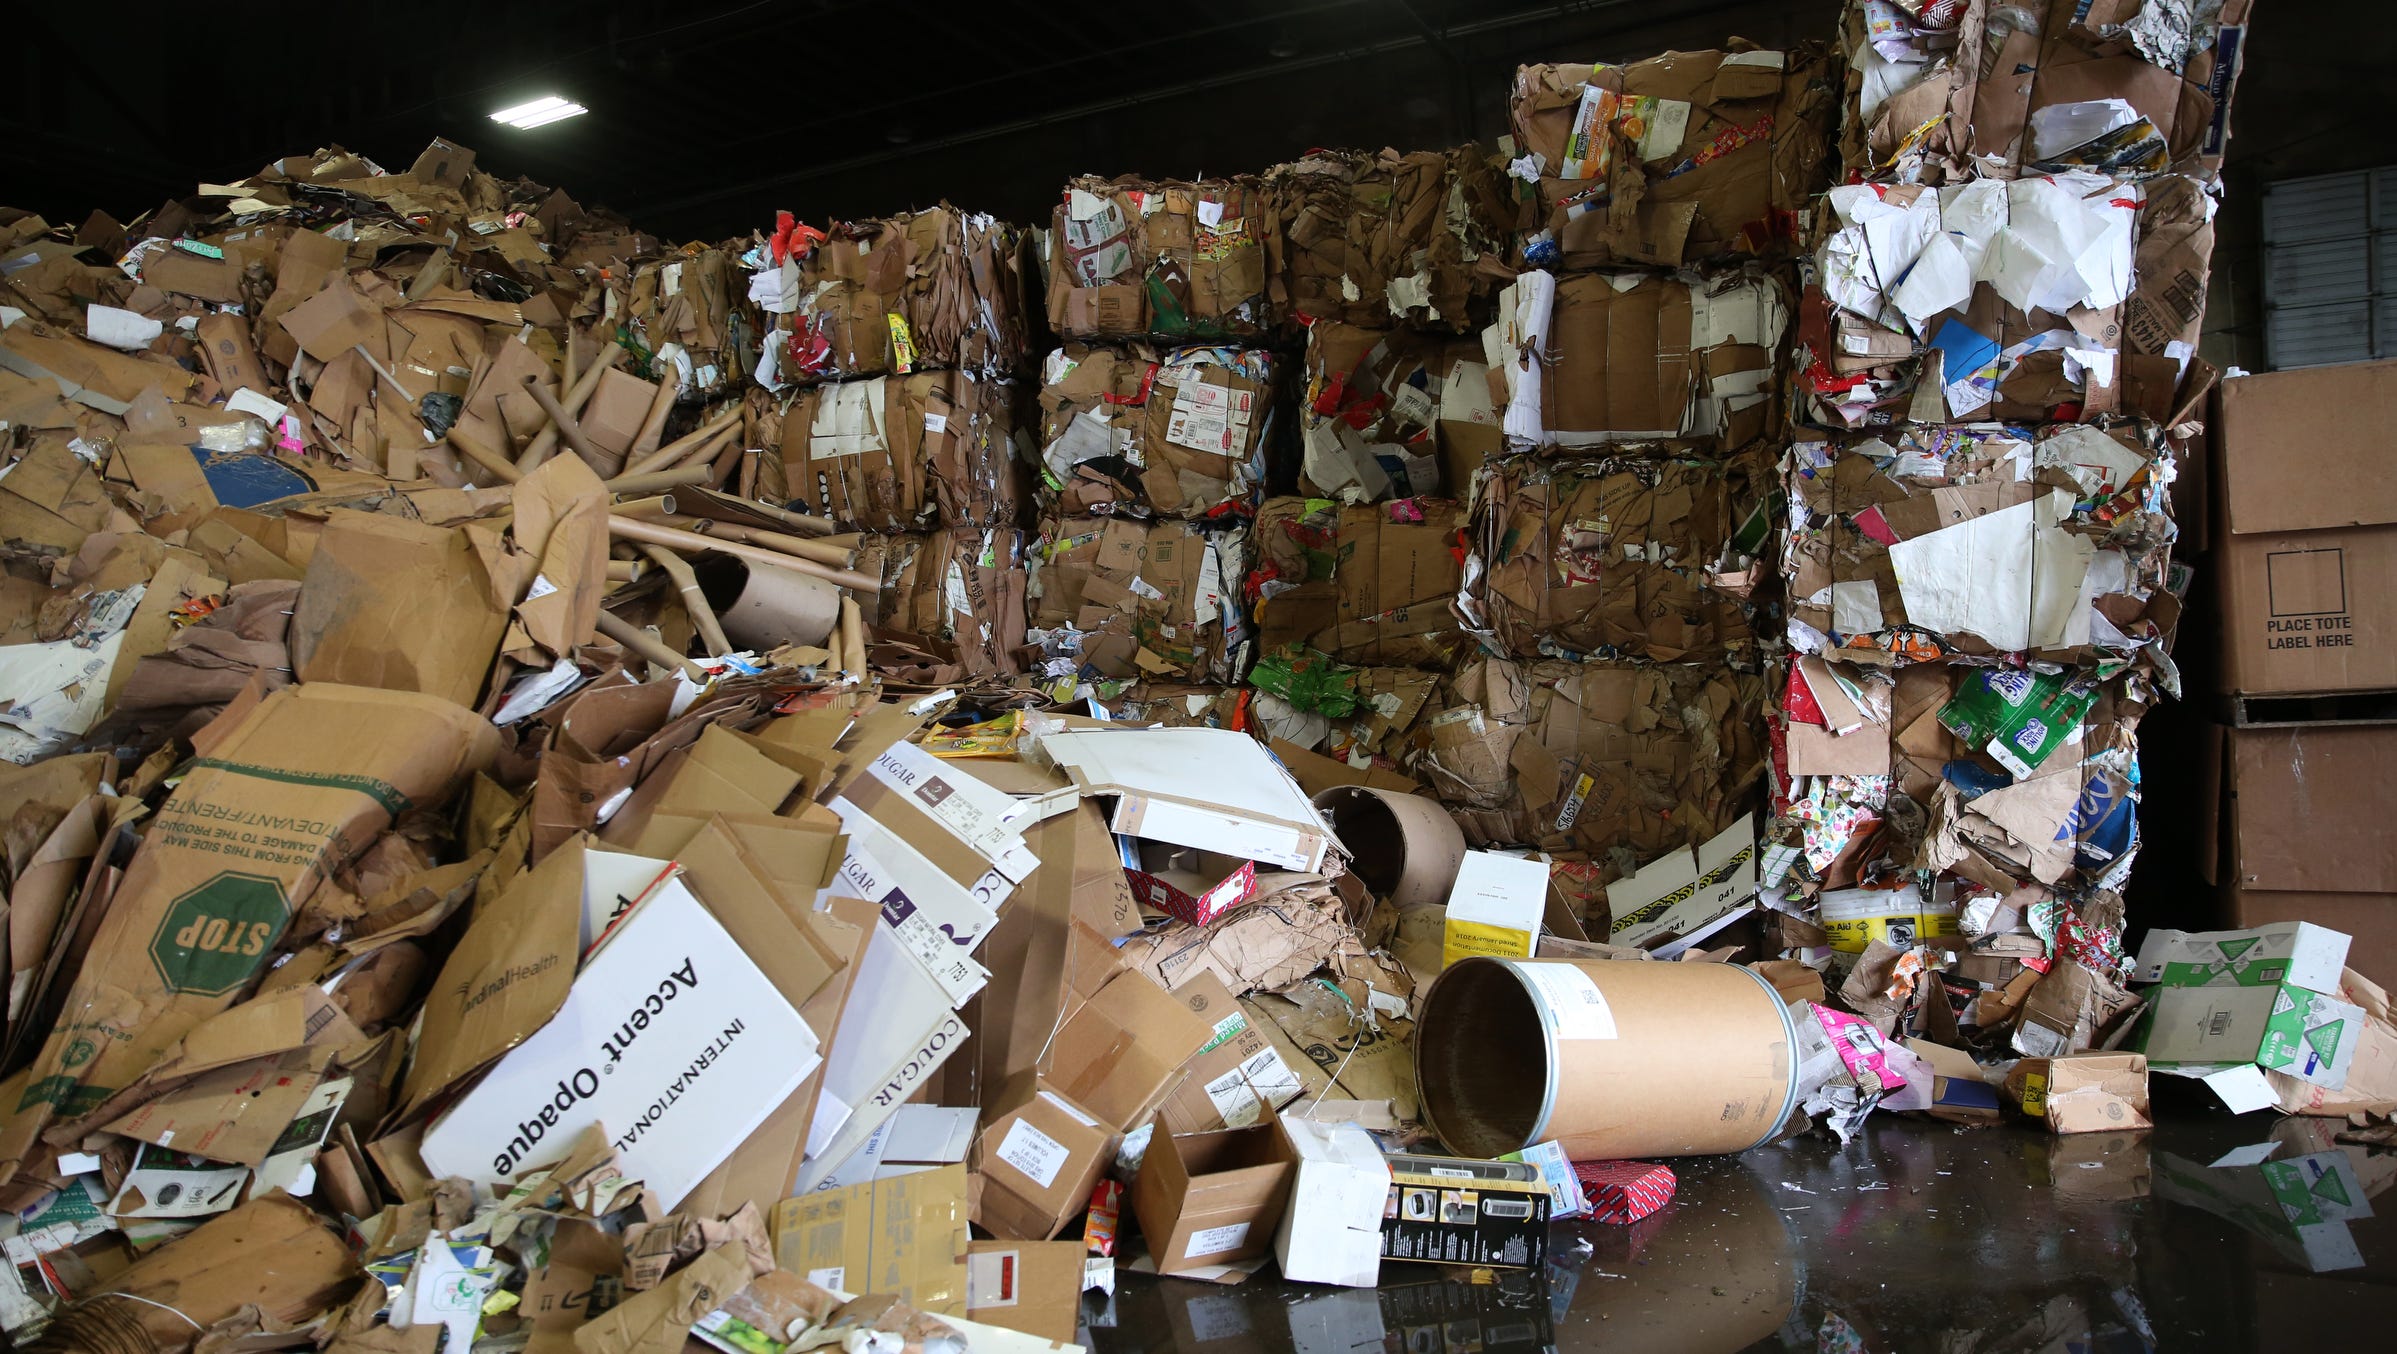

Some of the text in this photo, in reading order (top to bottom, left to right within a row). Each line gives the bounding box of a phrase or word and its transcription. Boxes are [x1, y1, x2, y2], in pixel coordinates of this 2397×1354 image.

[2267, 617, 2351, 632] PLACE TOTE
[2268, 635, 2353, 650] LABEL HERE
[152, 821, 210, 836] PRODUCT
[213, 829, 238, 840] THE
[985, 826, 1006, 844] 7753
[161, 837, 189, 847] MAY
[191, 840, 221, 852] SIDE
[241, 833, 258, 843] TO
[260, 836, 317, 852] DAMAGE
[222, 845, 251, 857] THIS
[254, 849, 291, 863] FROM
[1718, 886, 1735, 902] 041
[175, 913, 272, 955] STOP
[1452, 942, 1502, 954] Documentation
[1164, 952, 1189, 971] 23116
[948, 961, 968, 982] 7753
[1217, 1013, 1241, 1031] OPEN
[1236, 1030, 1257, 1046] Qty 50
[1240, 1039, 1264, 1057] 14201
[614, 1017, 745, 1154] INTERNATIONAL
[493, 1066, 599, 1177] Opaque
[1028, 1140, 1050, 1158] VOLUMES
